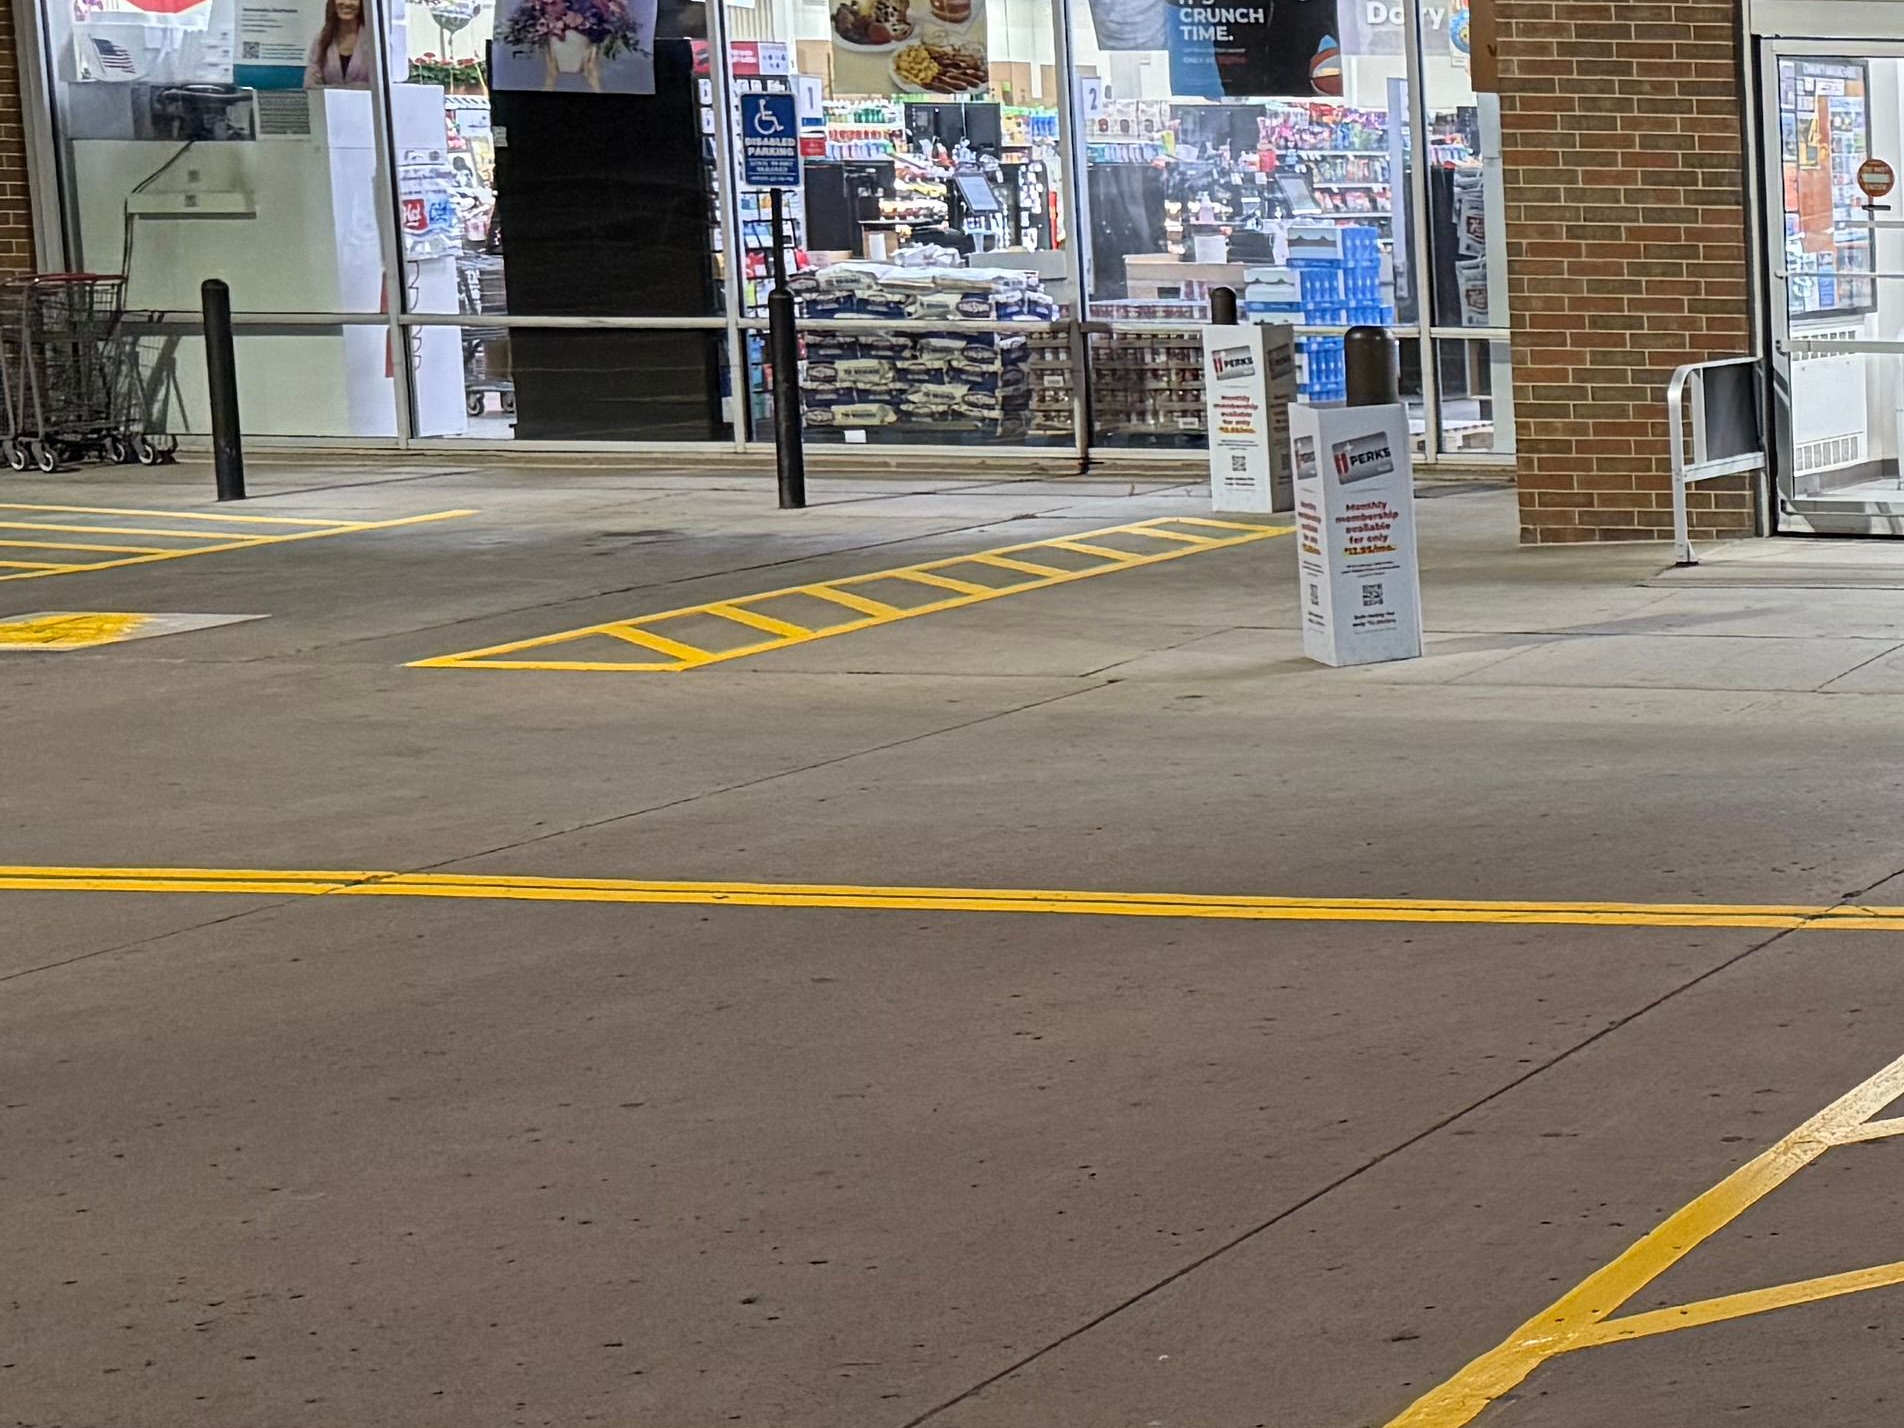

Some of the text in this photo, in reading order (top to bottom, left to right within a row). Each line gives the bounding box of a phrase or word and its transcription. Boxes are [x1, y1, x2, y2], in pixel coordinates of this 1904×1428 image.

[1179, 7, 1265, 23] CRUNCH
[1178, 25, 1234, 41] TIME.
[745, 137, 796, 147] DISABLED
[747, 146, 795, 157] PARKING
[1350, 446, 1391, 468] PERKS
